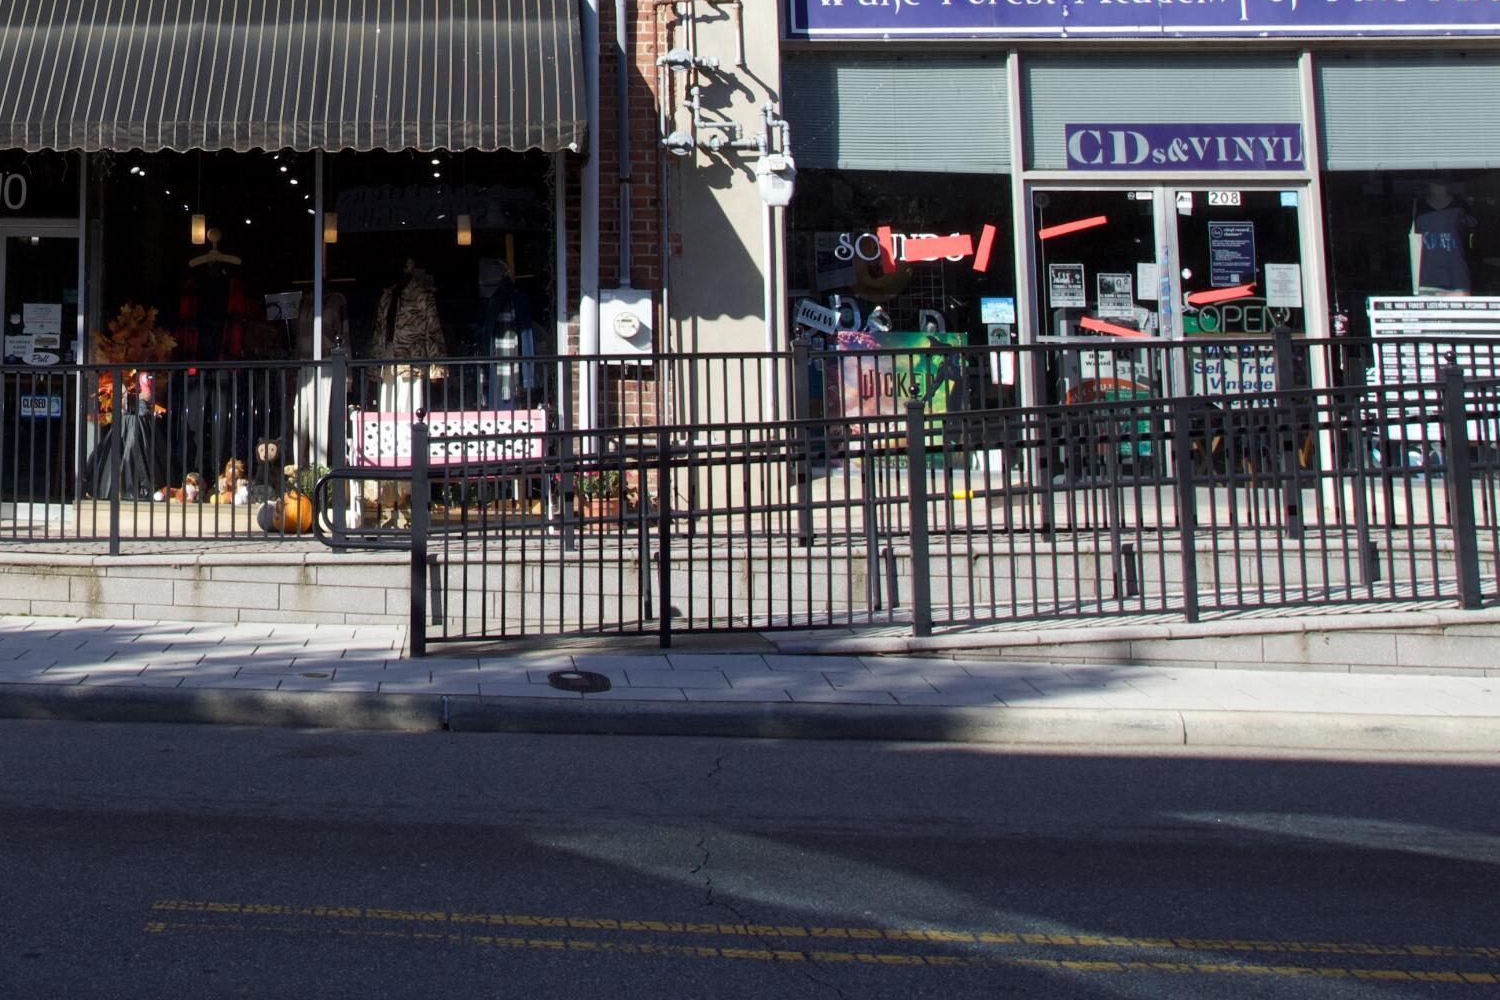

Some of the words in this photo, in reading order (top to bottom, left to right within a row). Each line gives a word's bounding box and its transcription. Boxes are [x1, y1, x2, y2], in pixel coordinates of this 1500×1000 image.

[1211, 192, 1239, 204] 208
[1198, 305, 1284, 332] OPEN
[31, 354, 50, 363] Pull
[1085, 359, 1111, 367] Wted
[1210, 377, 1273, 392] Vnage
